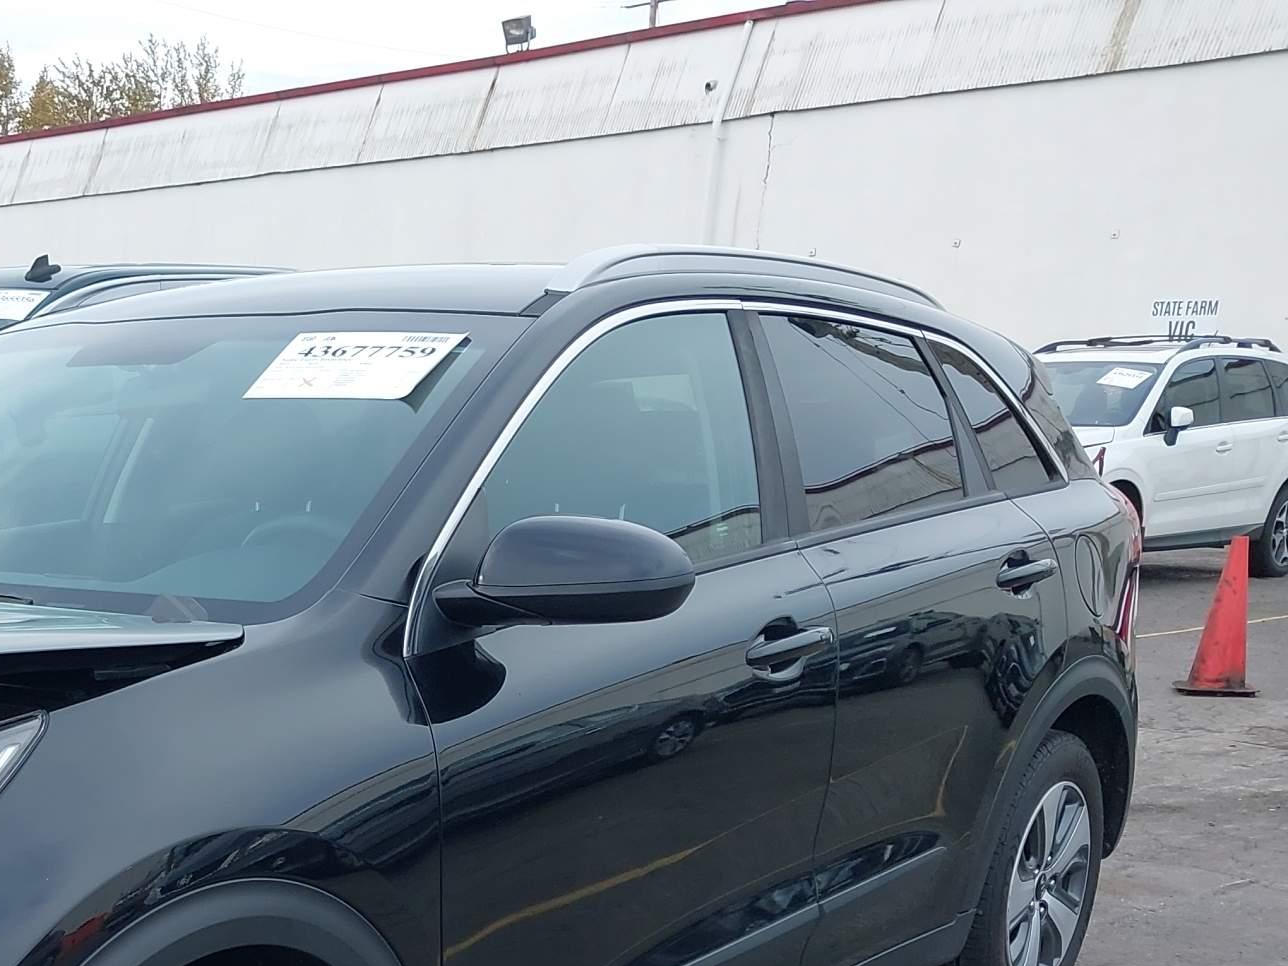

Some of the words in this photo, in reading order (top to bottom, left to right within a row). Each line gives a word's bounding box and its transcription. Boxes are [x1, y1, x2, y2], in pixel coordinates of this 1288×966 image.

[1152, 300, 1184, 317] STATE
[1185, 299, 1219, 316] FARM
[1168, 320, 1196, 341] VIC
[297, 345, 436, 358] 43677759
